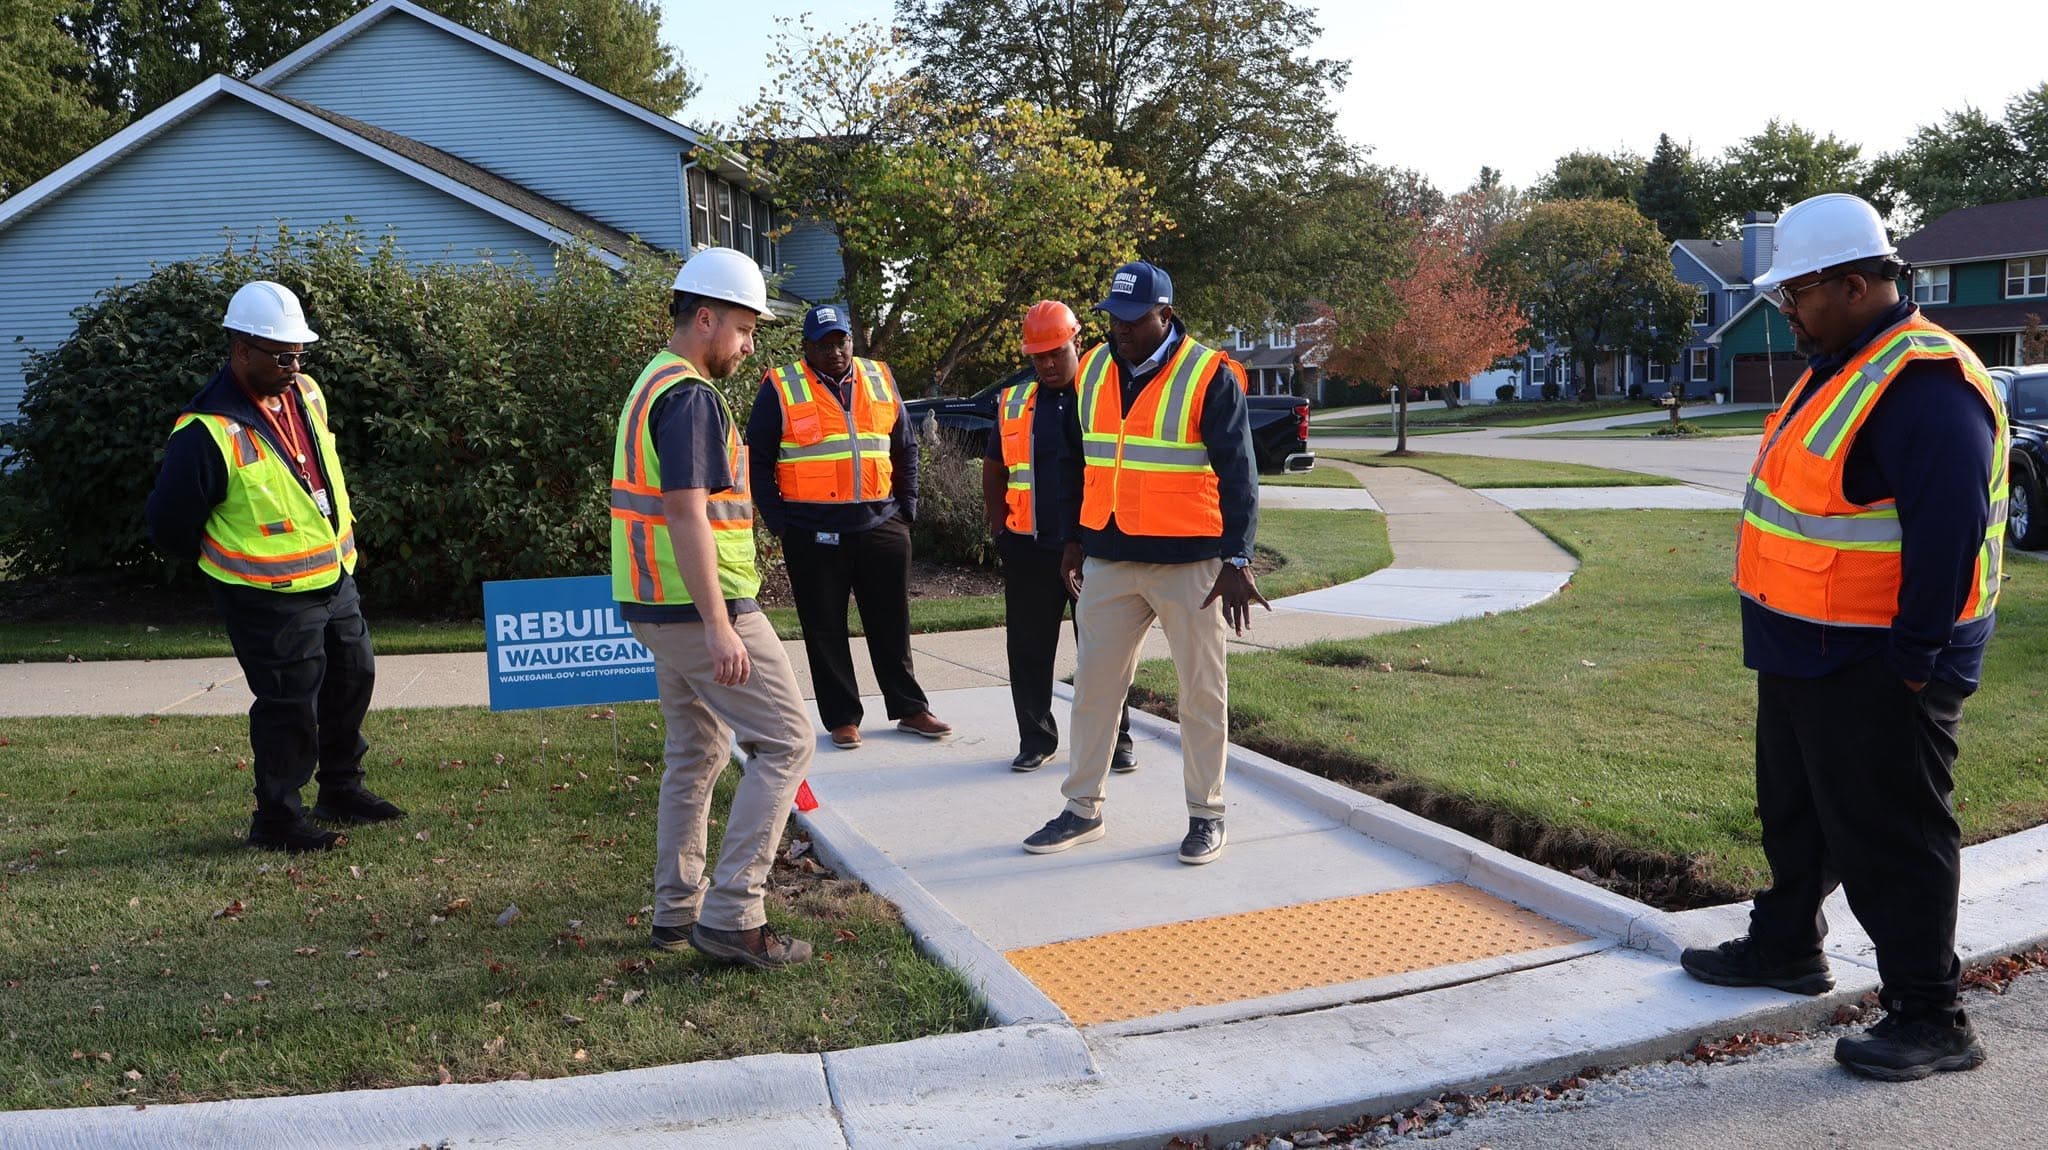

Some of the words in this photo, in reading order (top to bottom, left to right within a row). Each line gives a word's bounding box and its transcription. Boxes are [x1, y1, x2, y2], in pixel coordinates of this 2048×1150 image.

[495, 607, 633, 641] REBUIL
[506, 642, 648, 667] WAUKEGAN
[500, 671, 575, 683] WAUKEGANIL.GOV
[580, 666, 656, 678] #CITYOFPROGRESS
